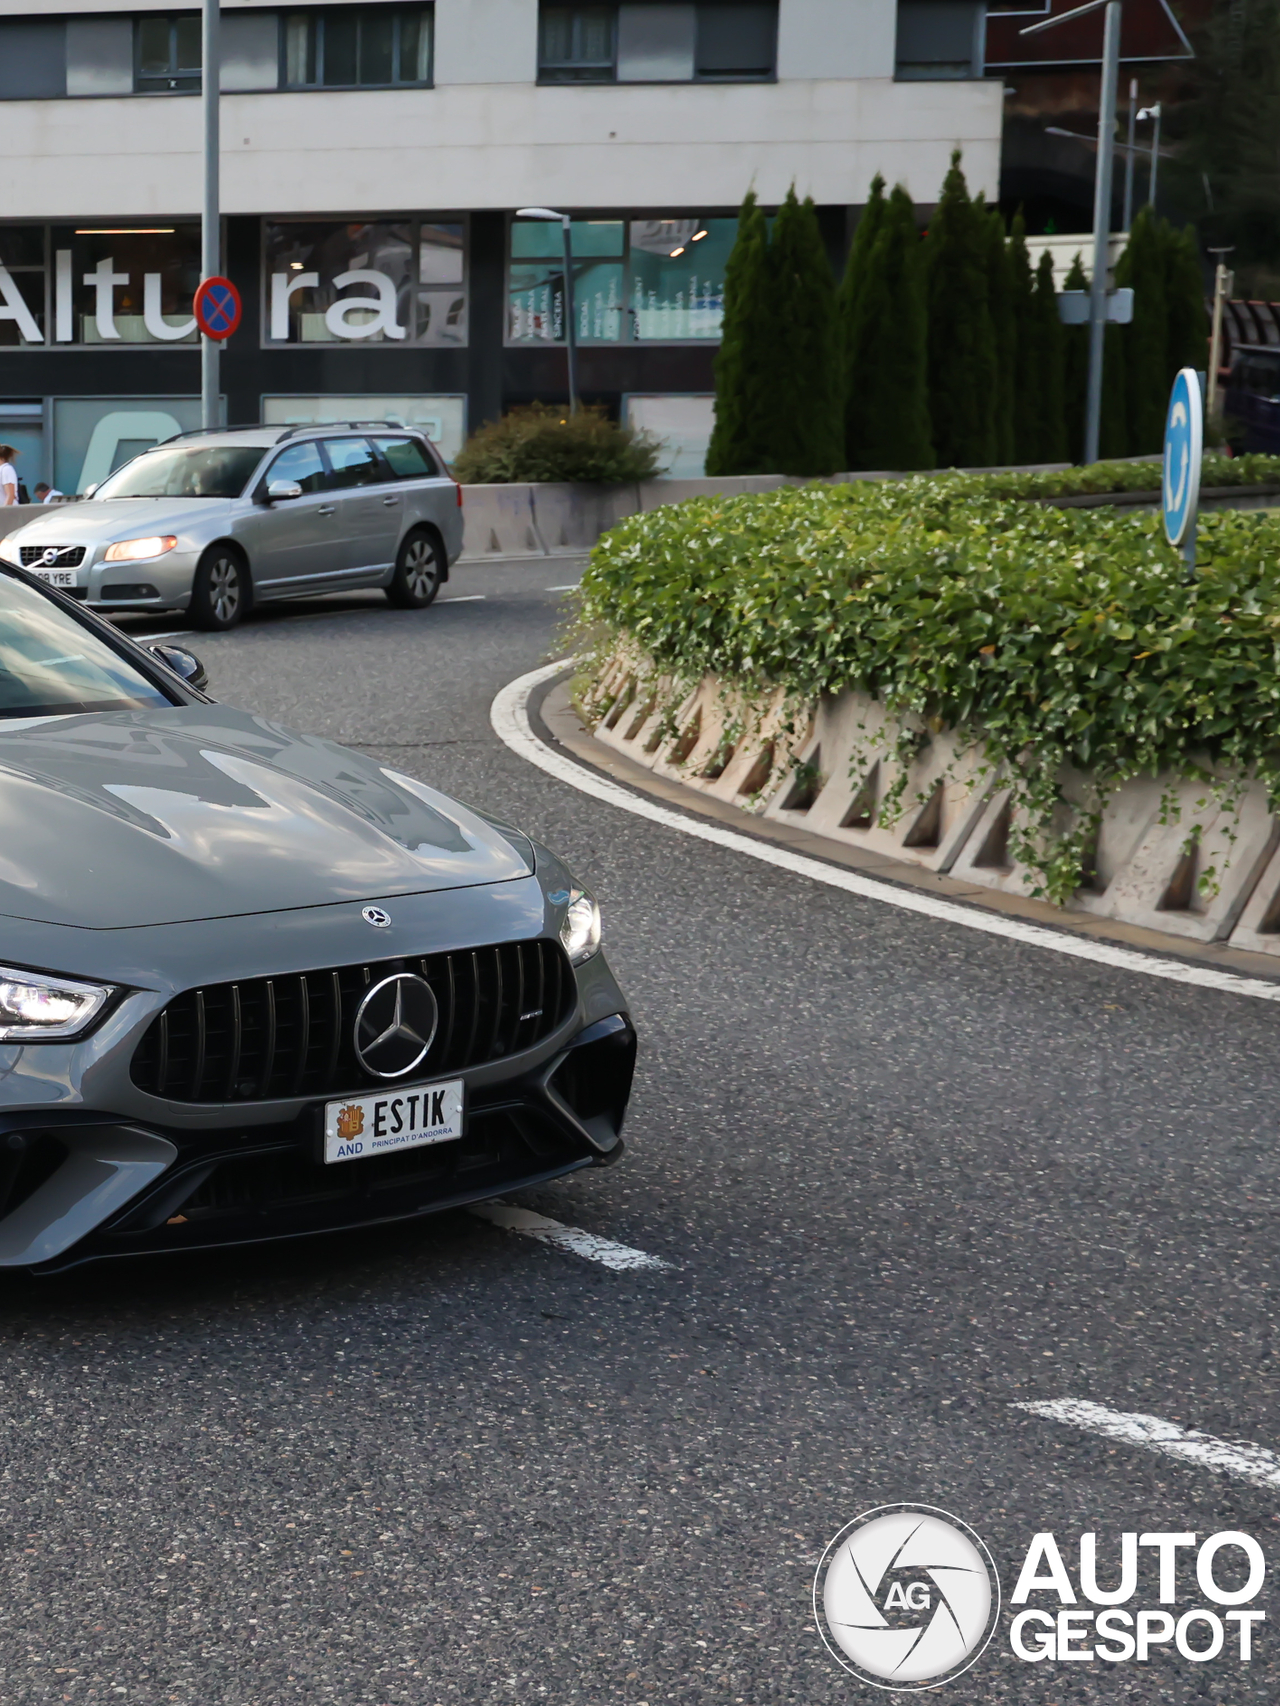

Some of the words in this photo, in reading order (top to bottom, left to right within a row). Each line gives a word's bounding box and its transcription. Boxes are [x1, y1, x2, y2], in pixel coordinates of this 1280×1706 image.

[553, 291, 562, 338] SINCERA
[52, 573, 72, 585] YRE
[374, 1089, 446, 1138] ESTIK
[372, 1135, 410, 1149] PRINCIPAT
[412, 1126, 453, 1142] D'ANDORRA
[336, 1142, 364, 1158] AND
